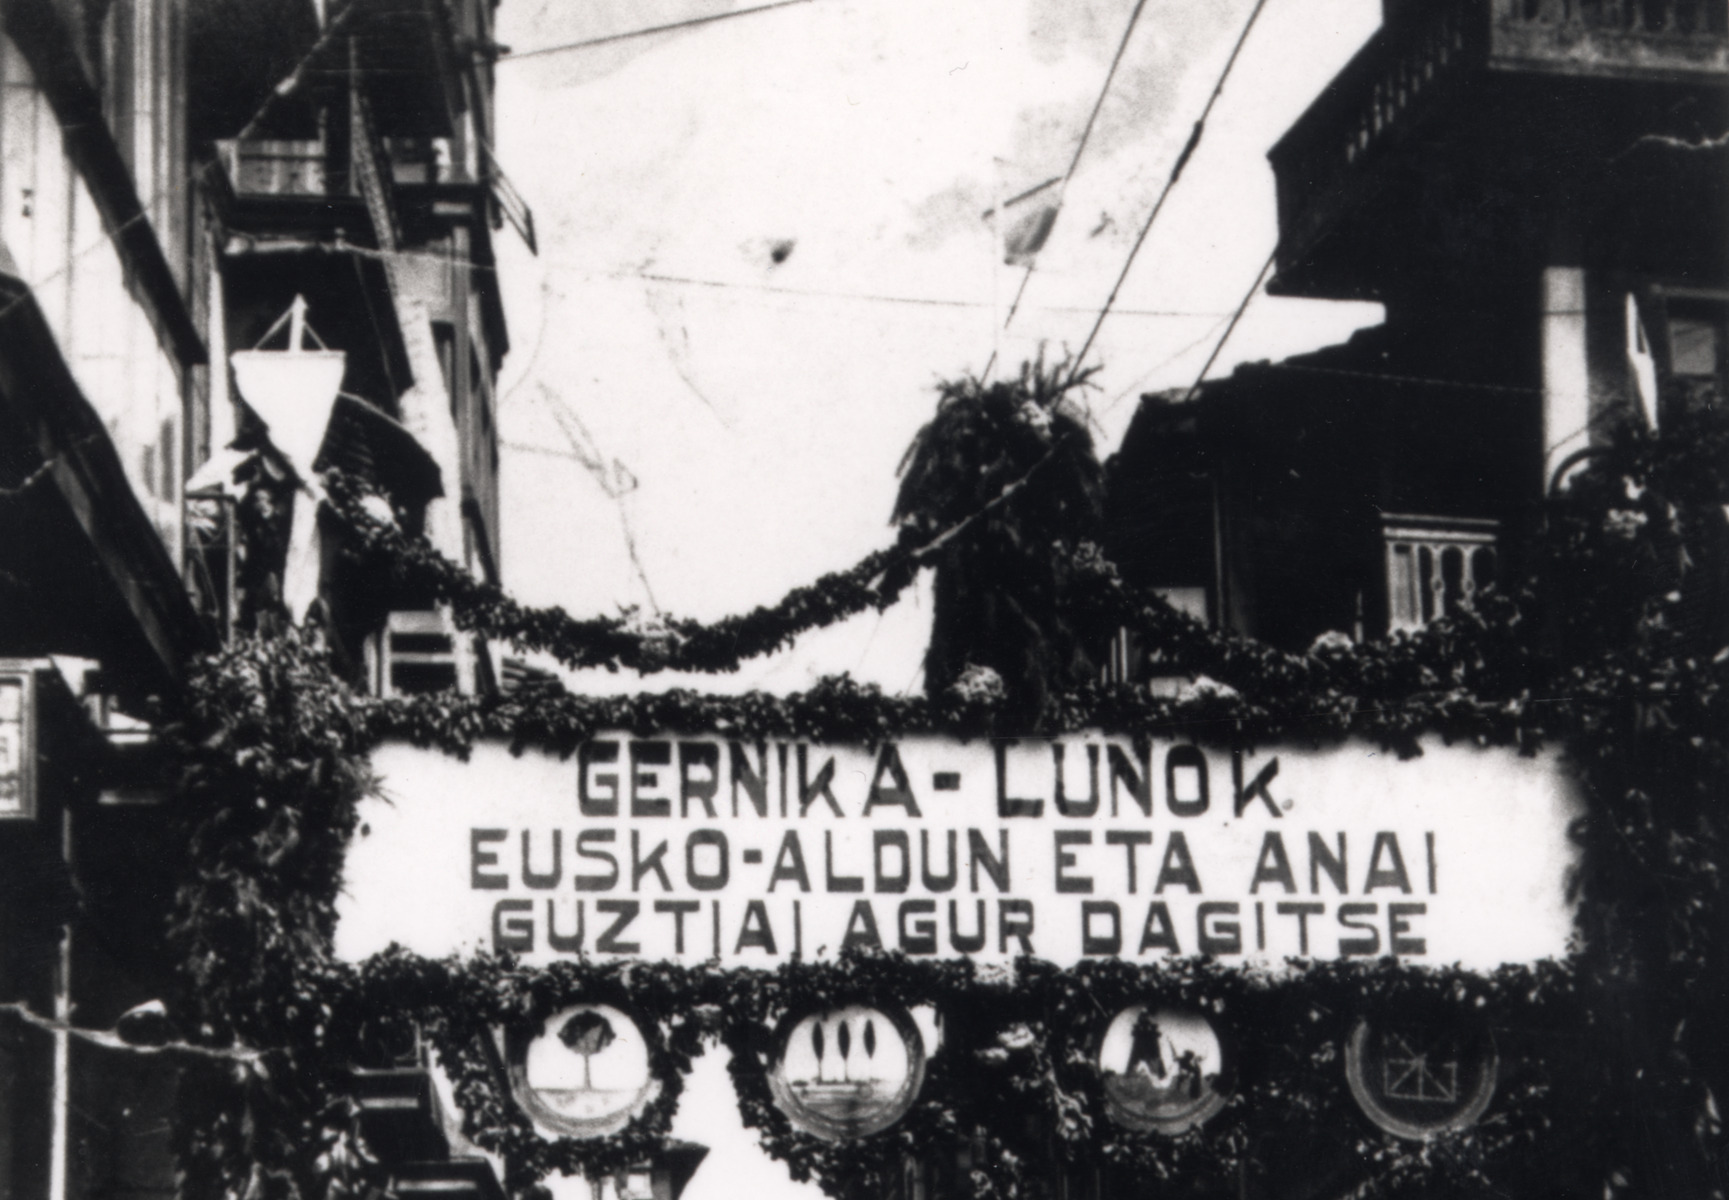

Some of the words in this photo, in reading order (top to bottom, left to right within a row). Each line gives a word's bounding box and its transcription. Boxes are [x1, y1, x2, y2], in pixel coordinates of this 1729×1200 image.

[470, 827, 1009, 893] EUSKO-ALDUN
[1053, 829, 1202, 894] ETA
[1249, 829, 1438, 895] ANAI
[492, 899, 803, 957] GUZTIAI
[840, 899, 1035, 955] AGUR
[1082, 901, 1427, 956] DAGITSE
